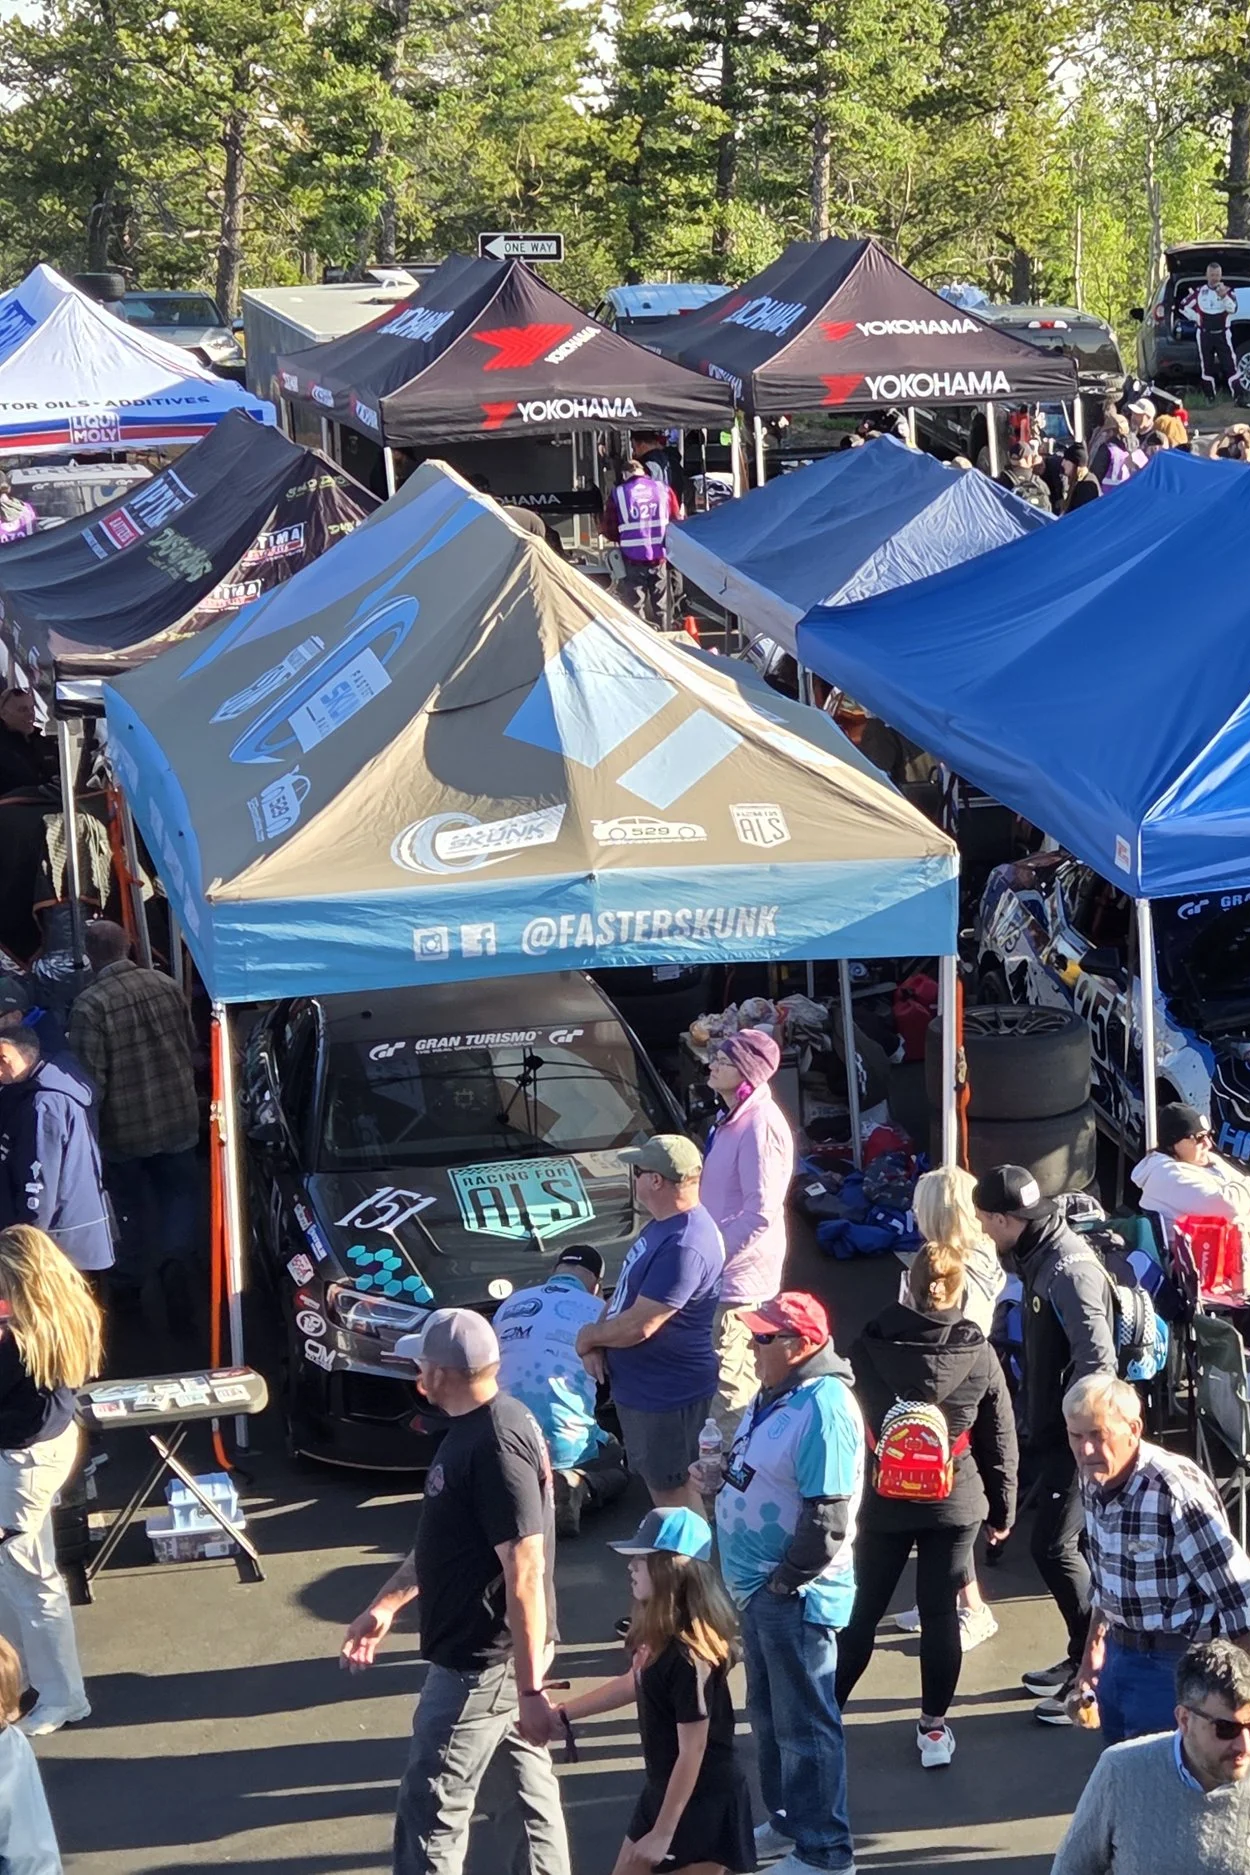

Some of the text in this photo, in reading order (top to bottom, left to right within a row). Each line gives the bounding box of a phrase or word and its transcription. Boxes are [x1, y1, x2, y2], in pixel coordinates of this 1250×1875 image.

[504, 241, 554, 255] ONE WAY
[855, 318, 979, 337] YOKOHAMA
[543, 326, 601, 365] YOKOHAMA
[865, 370, 1011, 400] YOKOHAMA
[45, 399, 91, 410] OILS
[103, 395, 210, 409] ADDITIVES
[517, 397, 638, 423] YOKOHAMA
[72, 414, 118, 430] LIQUI
[73, 429, 117, 443] MOLY
[494, 494, 561, 506] OHAMA
[630, 503, 658, 519] 027
[256, 525, 302, 550] TIMA
[449, 818, 546, 849] SKUNK
[631, 826, 670, 836] 529
[738, 817, 785, 845] ALS
[521, 905, 779, 956] @FASTERSKUNK
[415, 1034, 460, 1051] GRAN
[465, 1030, 537, 1046] TURISMO
[462, 1165, 570, 1188] RACING FOR
[333, 1186, 438, 1236] 151
[467, 1178, 584, 1232] ALS
